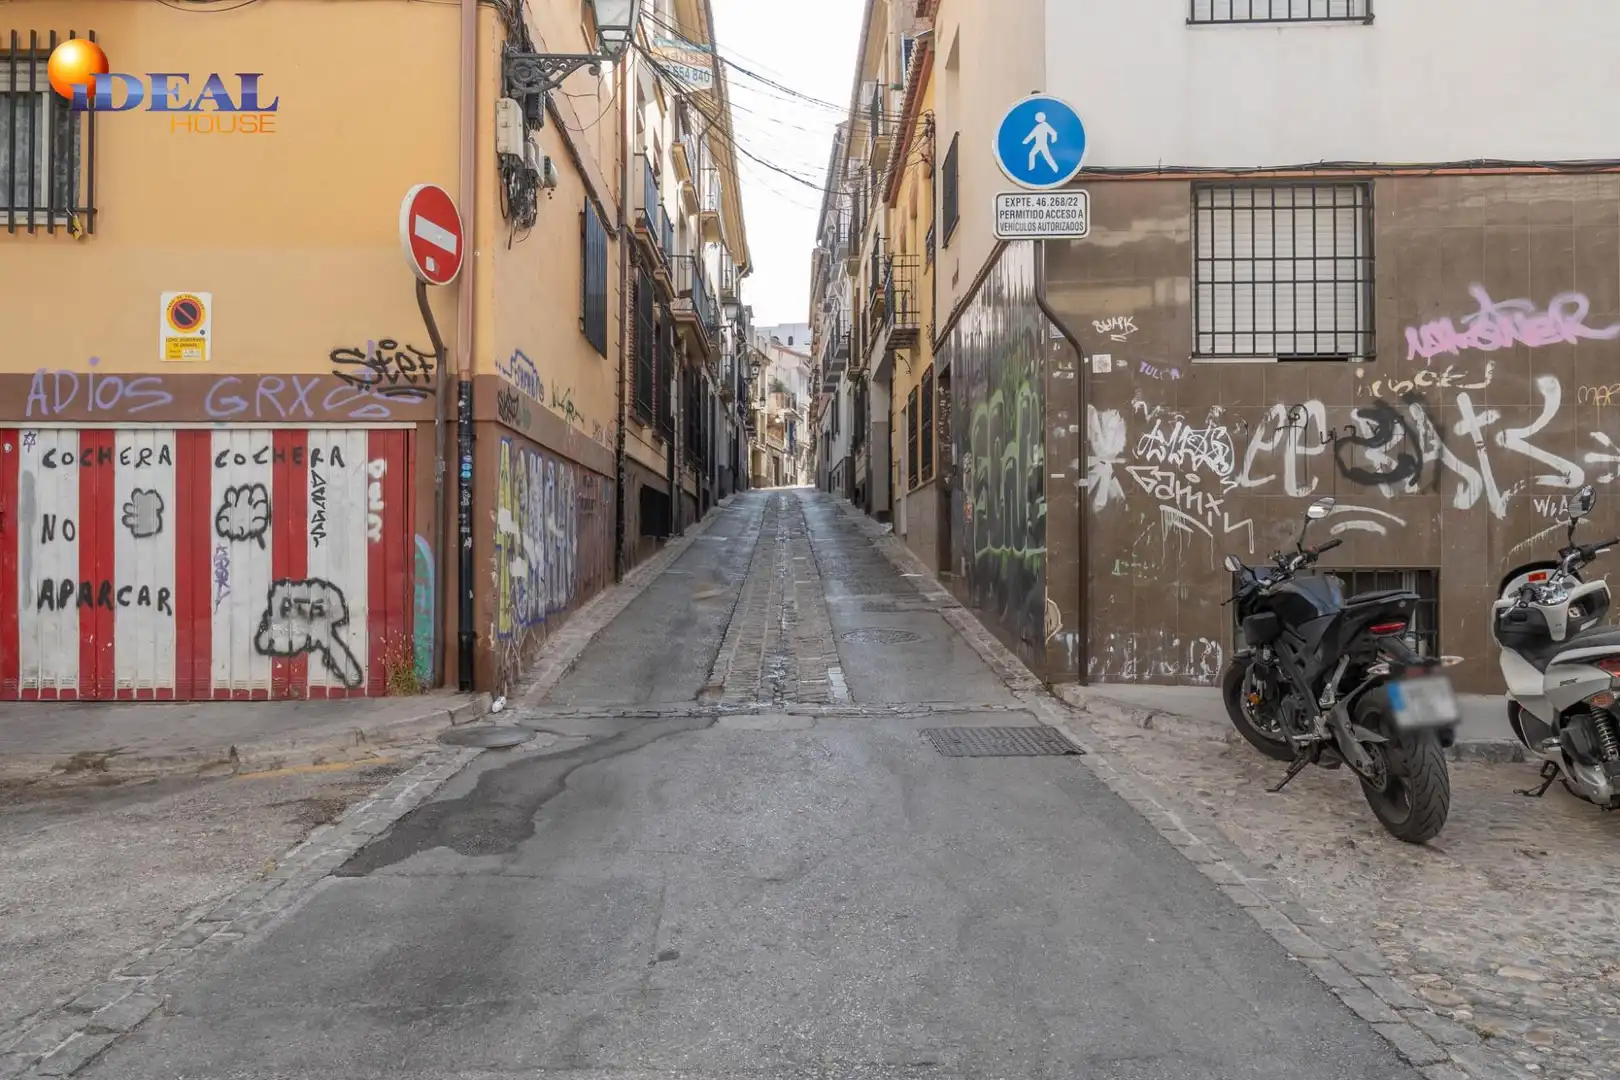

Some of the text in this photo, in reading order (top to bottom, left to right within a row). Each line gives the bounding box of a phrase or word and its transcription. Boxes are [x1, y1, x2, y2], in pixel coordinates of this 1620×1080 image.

[1005, 196, 1079, 207] EXPTE. 46.268/22
[1000, 209, 1084, 219] PERMITIDO ACCESO A
[1037, 221, 1084, 231] AUTORIZADOS
[42, 444, 345, 469] COCHERA COCHERA
[41, 513, 76, 544] NO
[38, 578, 173, 616] APARCAR
